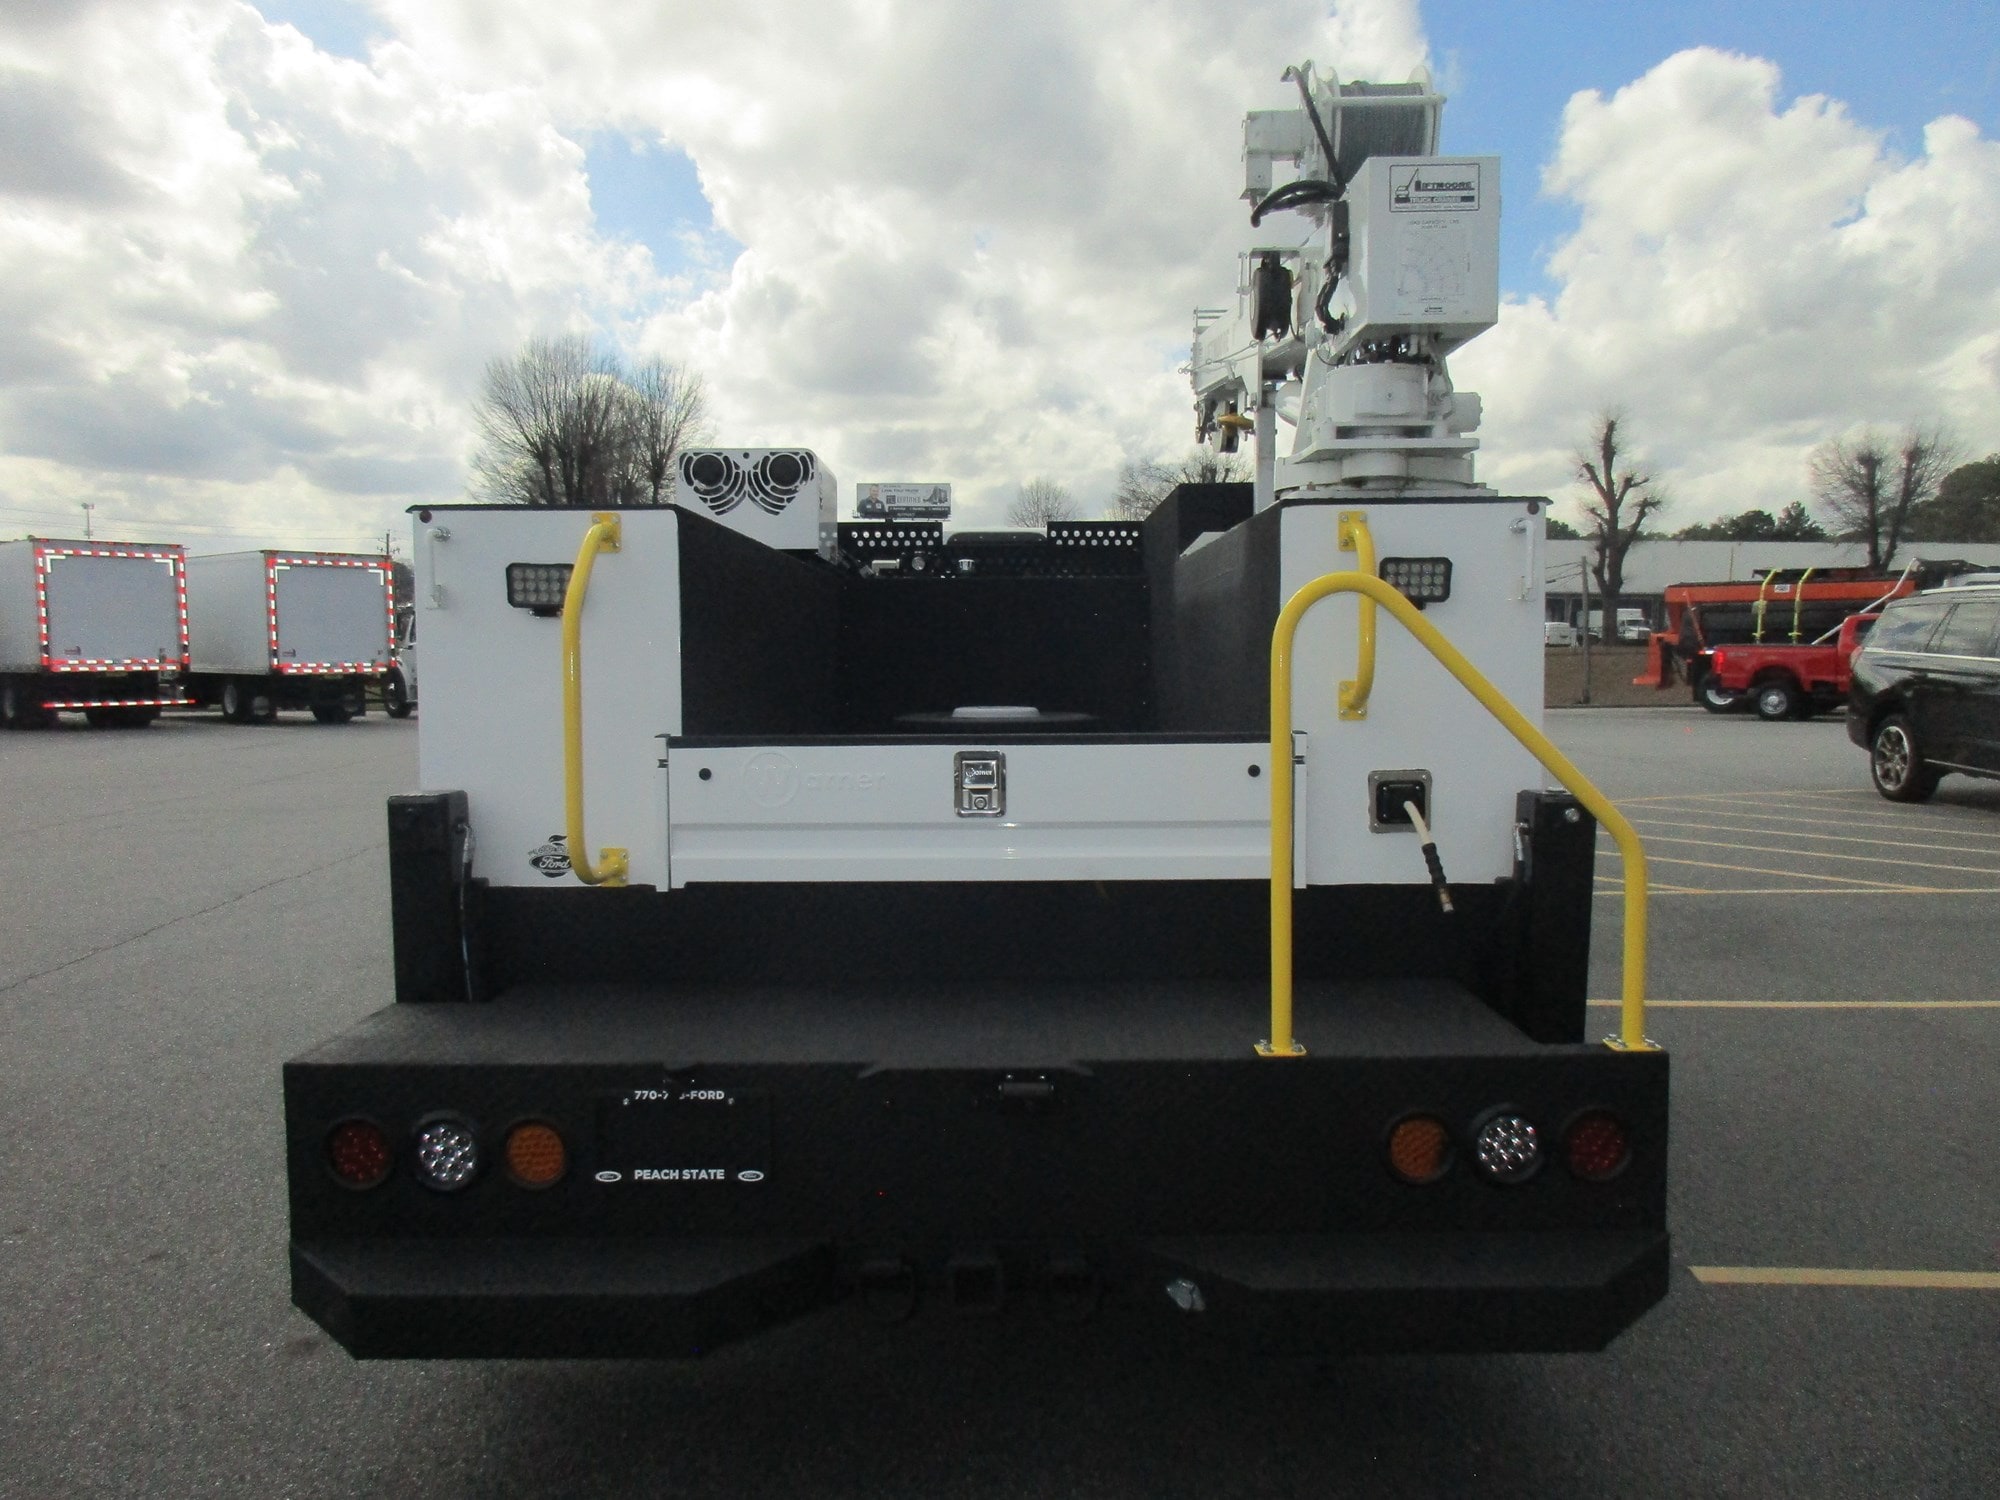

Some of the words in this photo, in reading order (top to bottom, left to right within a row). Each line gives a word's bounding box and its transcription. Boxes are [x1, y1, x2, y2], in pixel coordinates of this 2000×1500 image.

[539, 855, 570, 868] Ford
[634, 1169, 679, 1180] PEACH
[682, 1169, 725, 1180] STATE
